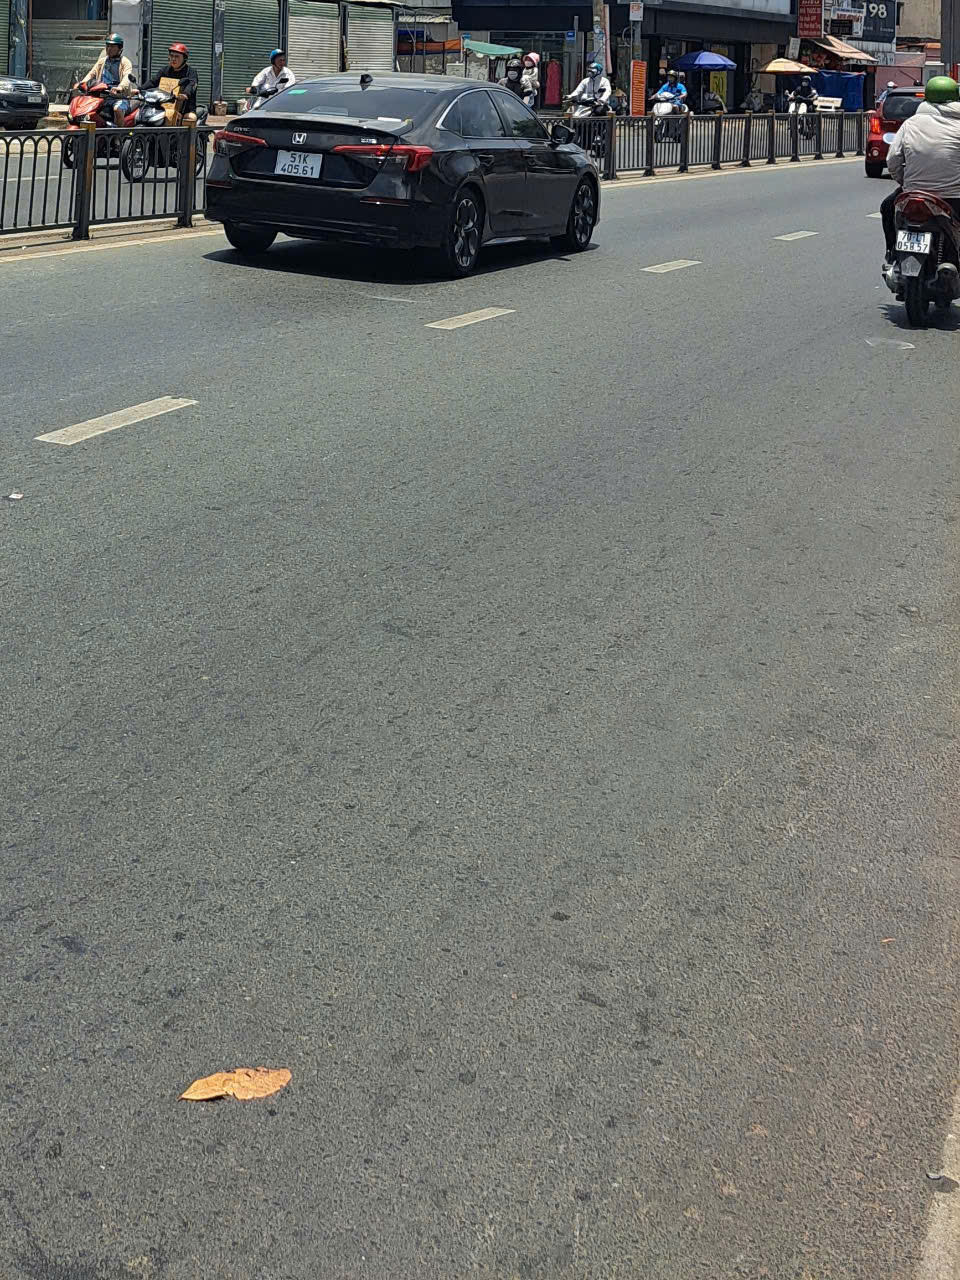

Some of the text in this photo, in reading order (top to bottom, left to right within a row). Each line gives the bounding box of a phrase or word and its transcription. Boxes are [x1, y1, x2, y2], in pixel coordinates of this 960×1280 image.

[862, 2, 887, 19] 198
[290, 153, 310, 165] 51K
[280, 163, 315, 177] 405.61
